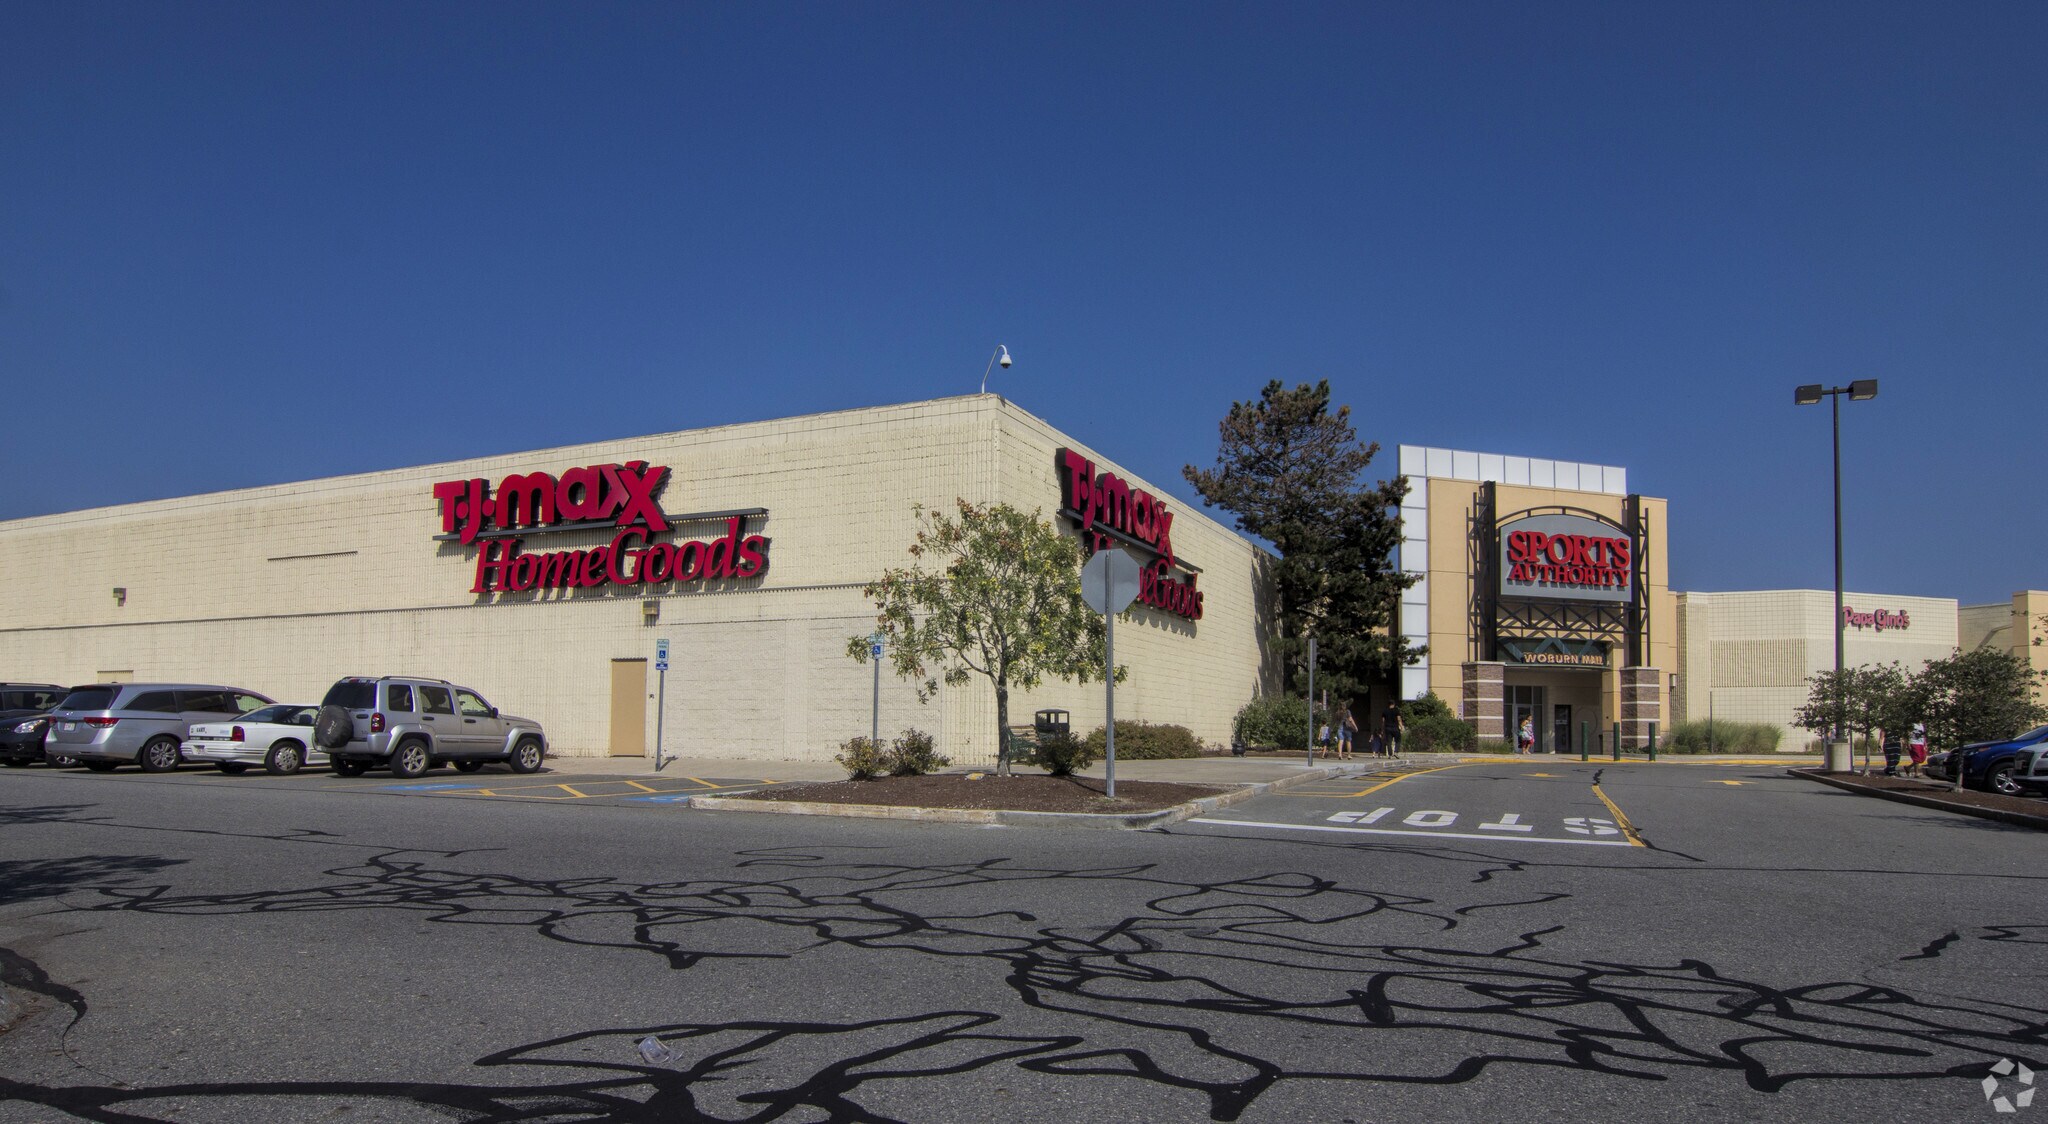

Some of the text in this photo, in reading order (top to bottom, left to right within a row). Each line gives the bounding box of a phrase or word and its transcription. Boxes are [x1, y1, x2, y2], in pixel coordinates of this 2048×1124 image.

[469, 516, 767, 593] HomeGoods
[1508, 530, 1631, 568] SPORTS
[1508, 562, 1631, 587] AUTHORITY
[1843, 606, 1874, 629] Papa
[1524, 652, 1604, 665] WOBURN MALL
[1326, 807, 1618, 835] STOP
